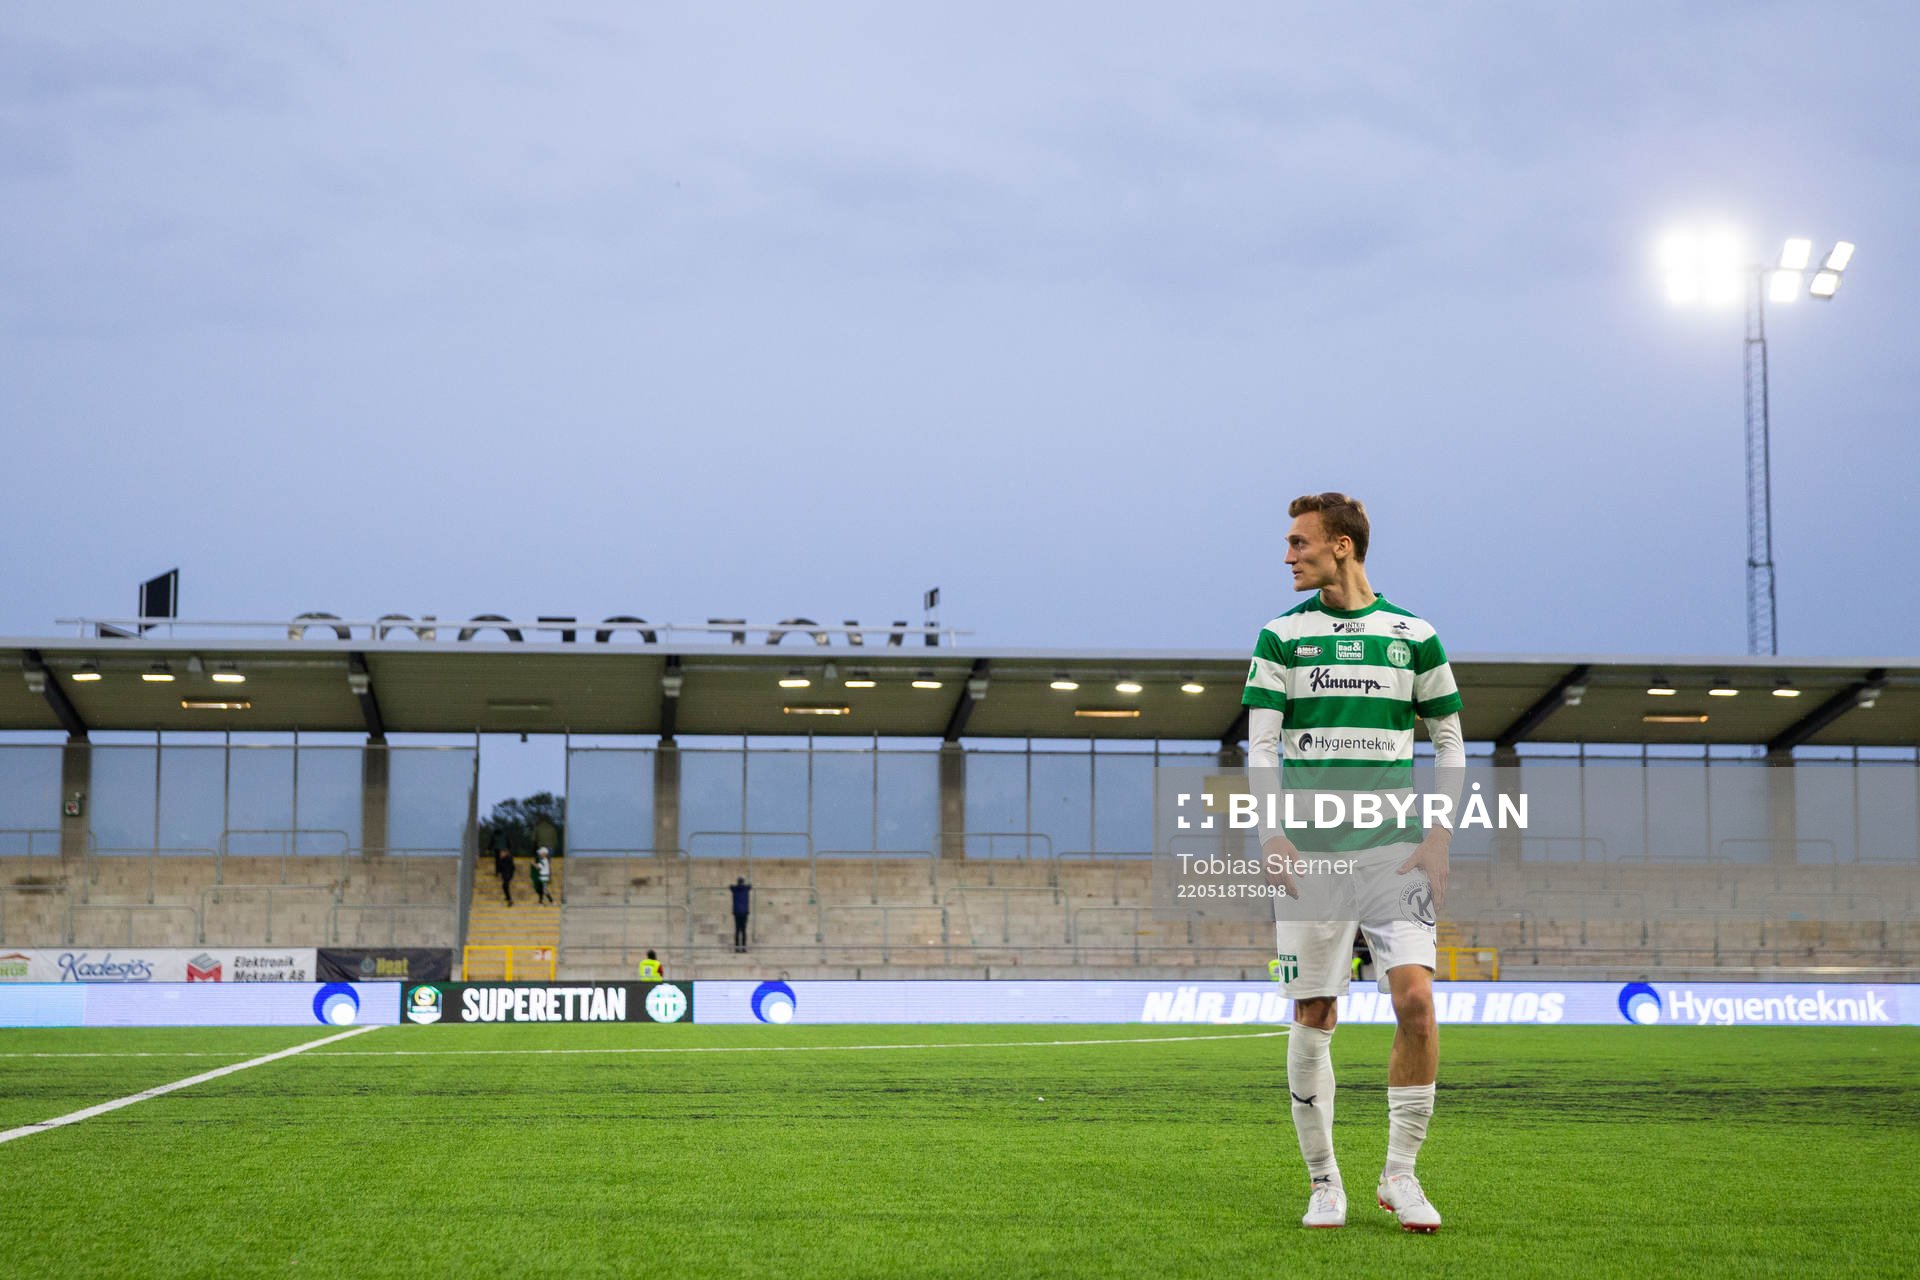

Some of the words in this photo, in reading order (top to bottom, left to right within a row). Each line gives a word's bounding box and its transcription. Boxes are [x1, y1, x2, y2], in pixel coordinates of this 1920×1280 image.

[1352, 641, 1362, 652] &
[1310, 667, 1390, 694] Kinnarps
[1315, 736, 1396, 751] Hygienteknik
[58, 952, 154, 982] Kadesjös
[234, 956, 294, 968] Elektronik
[233, 970, 282, 982] Mekanik
[288, 970, 306, 981] AB
[461, 988, 626, 1023] SUPERETTAN
[1141, 986, 1224, 1022] NÄR
[1482, 992, 1566, 1023] HOS
[1668, 989, 1889, 1025] Hygienteknik
